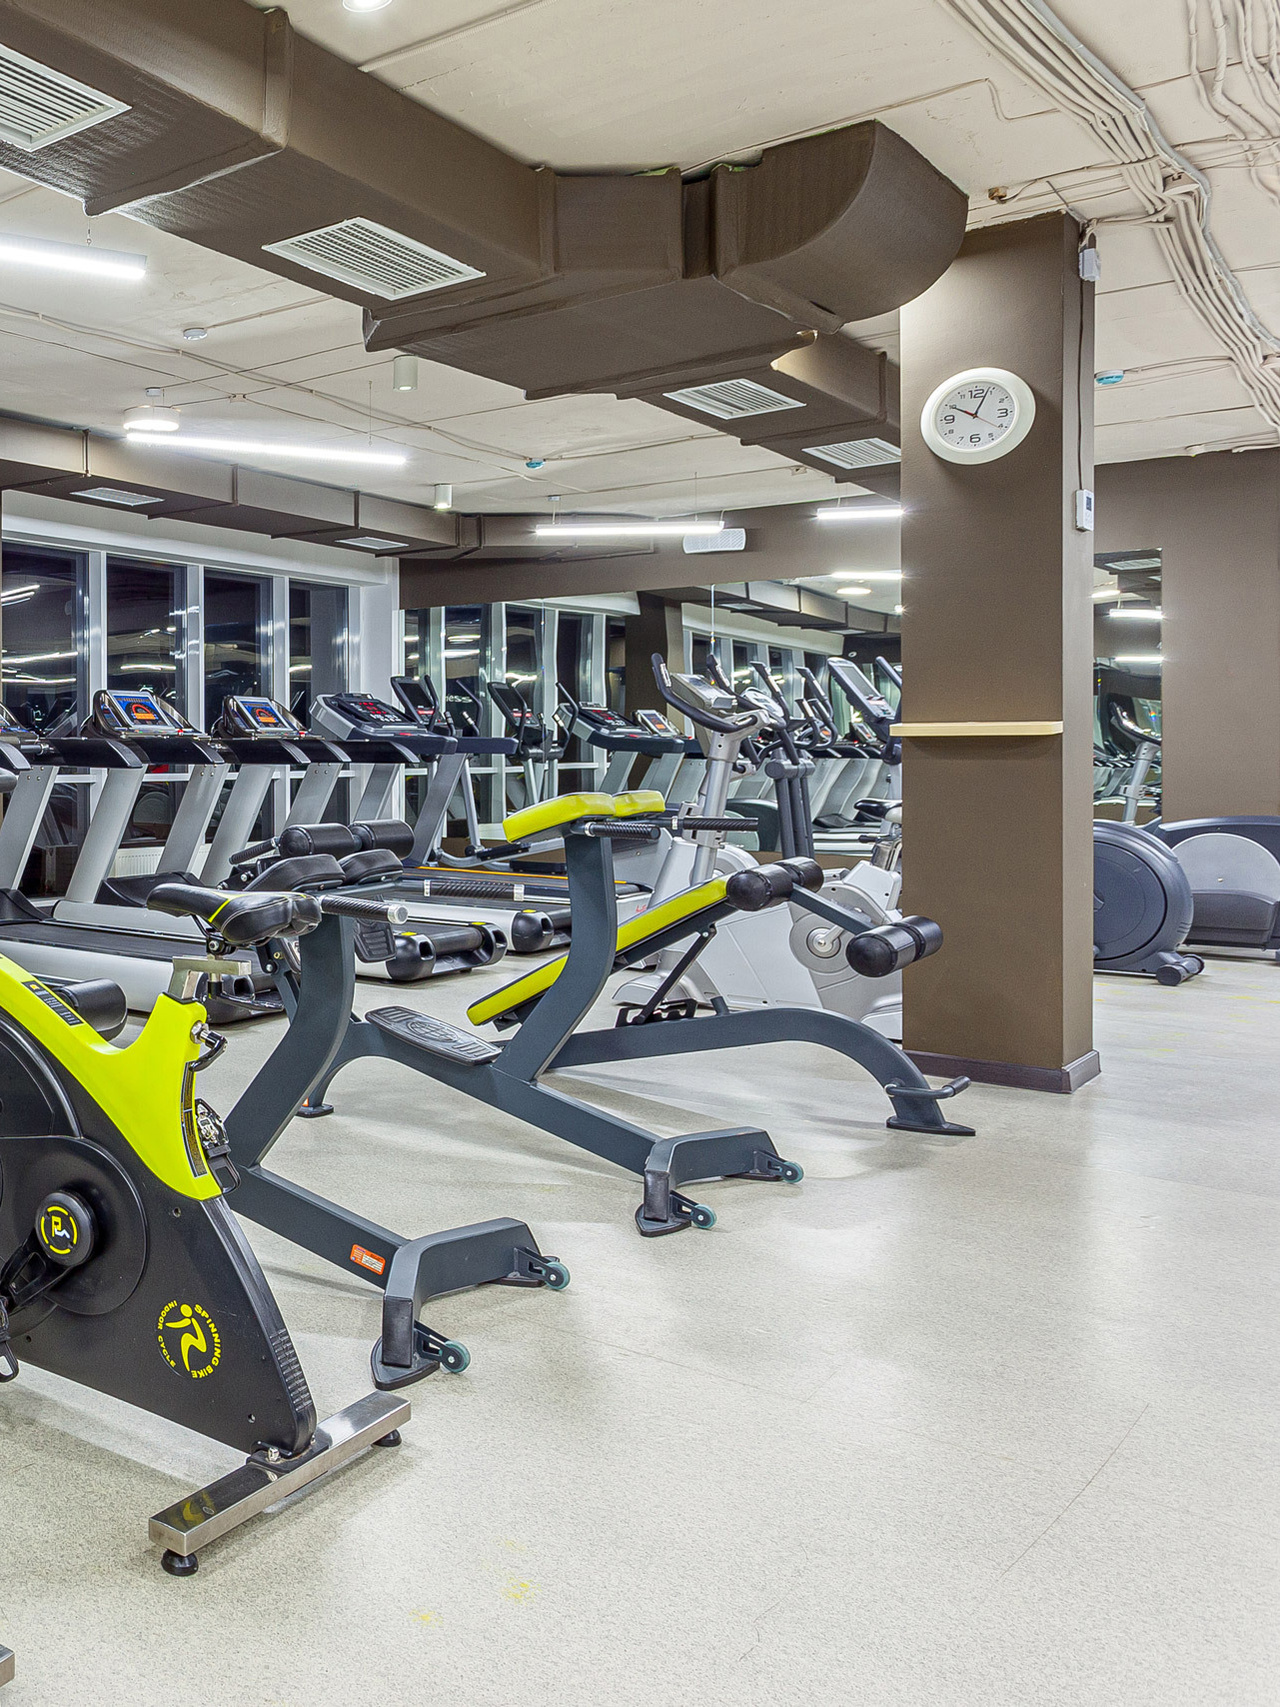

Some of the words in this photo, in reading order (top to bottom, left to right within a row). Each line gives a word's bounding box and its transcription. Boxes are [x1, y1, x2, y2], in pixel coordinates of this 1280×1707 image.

[968, 388, 985, 399] 12
[996, 408, 1009, 418] 3
[943, 414, 955, 425] 9
[969, 433, 981, 443] 6
[157, 1300, 178, 1330] INDOOR
[194, 1304, 221, 1367] SPINNING
[158, 1335, 177, 1368] CYCLE
[190, 1364, 214, 1378] BIKE
